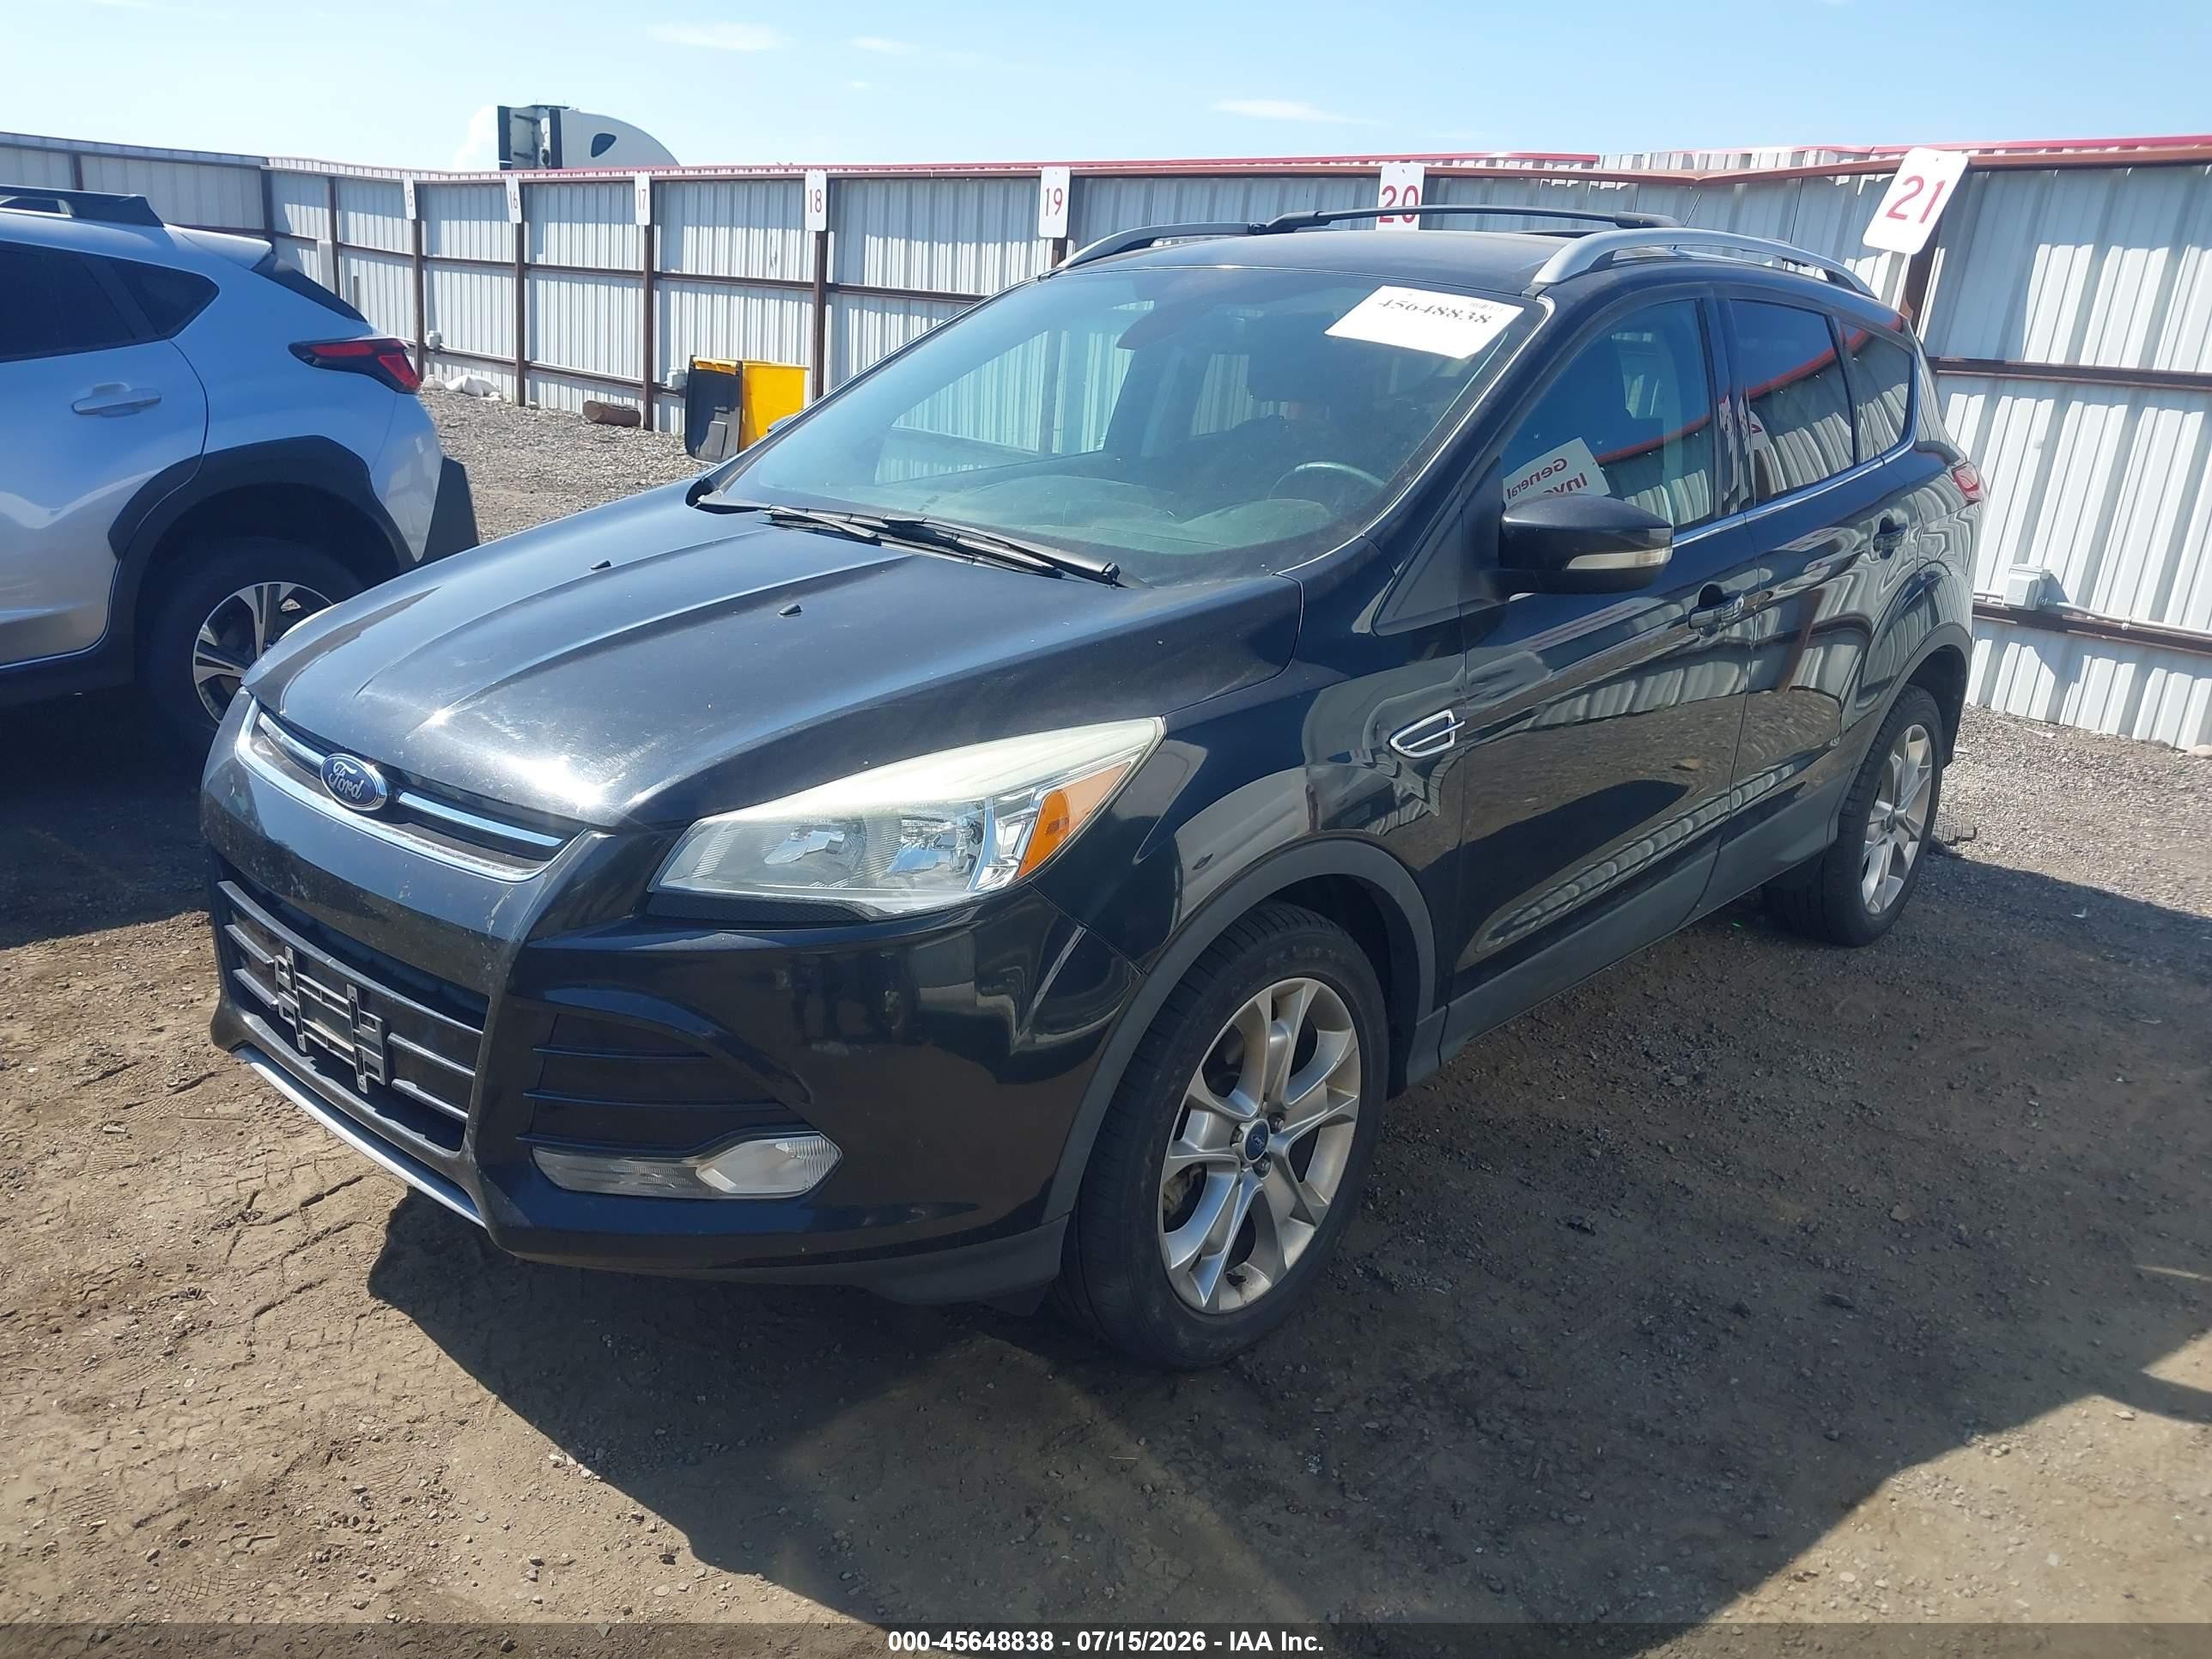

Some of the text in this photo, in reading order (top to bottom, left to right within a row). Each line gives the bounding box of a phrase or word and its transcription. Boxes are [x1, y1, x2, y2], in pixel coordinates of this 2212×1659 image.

[509, 190, 519, 210] 16
[638, 188, 647, 210] 17
[809, 188, 823, 214] 18
[1045, 187, 1063, 217] 19
[1379, 185, 1419, 223] 20
[1886, 175, 1946, 224] 21
[1377, 299, 1492, 324] 45648838
[328, 761, 365, 799] Ford
